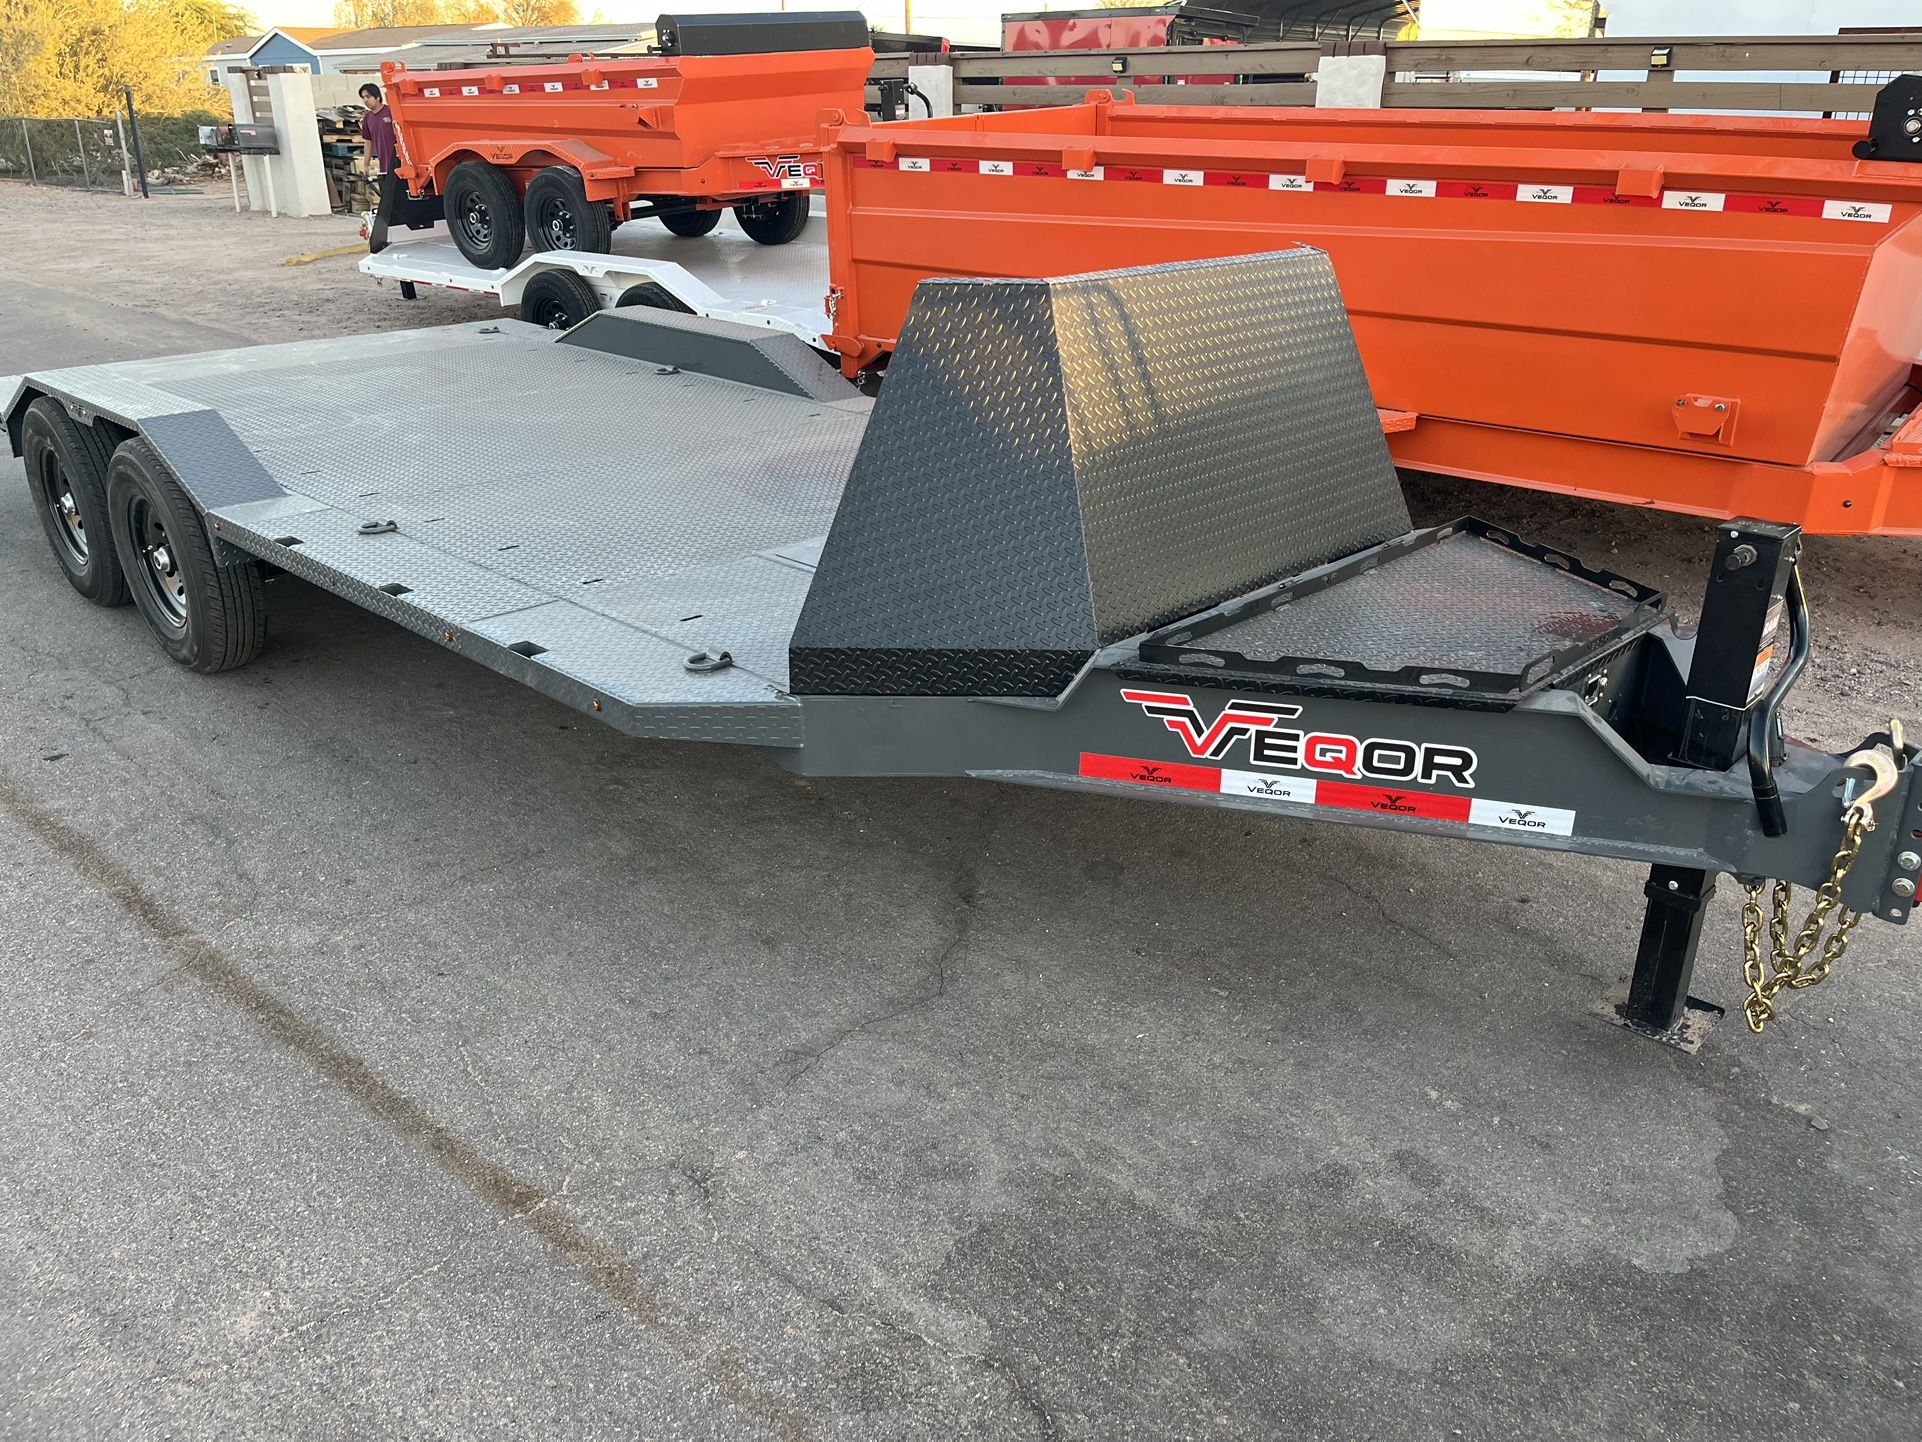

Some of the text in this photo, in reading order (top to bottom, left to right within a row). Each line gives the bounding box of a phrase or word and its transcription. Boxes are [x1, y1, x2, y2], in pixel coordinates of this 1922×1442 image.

[745, 154, 824, 180] VEQ
[1840, 211, 1872, 219] VEQOR
[1120, 688, 1478, 789] VEQOR
[1130, 773, 1172, 784] VEQOR
[1247, 785, 1291, 797] VEQOR
[1370, 801, 1417, 813] VEQOR
[1498, 816, 1546, 829] VEQOR
